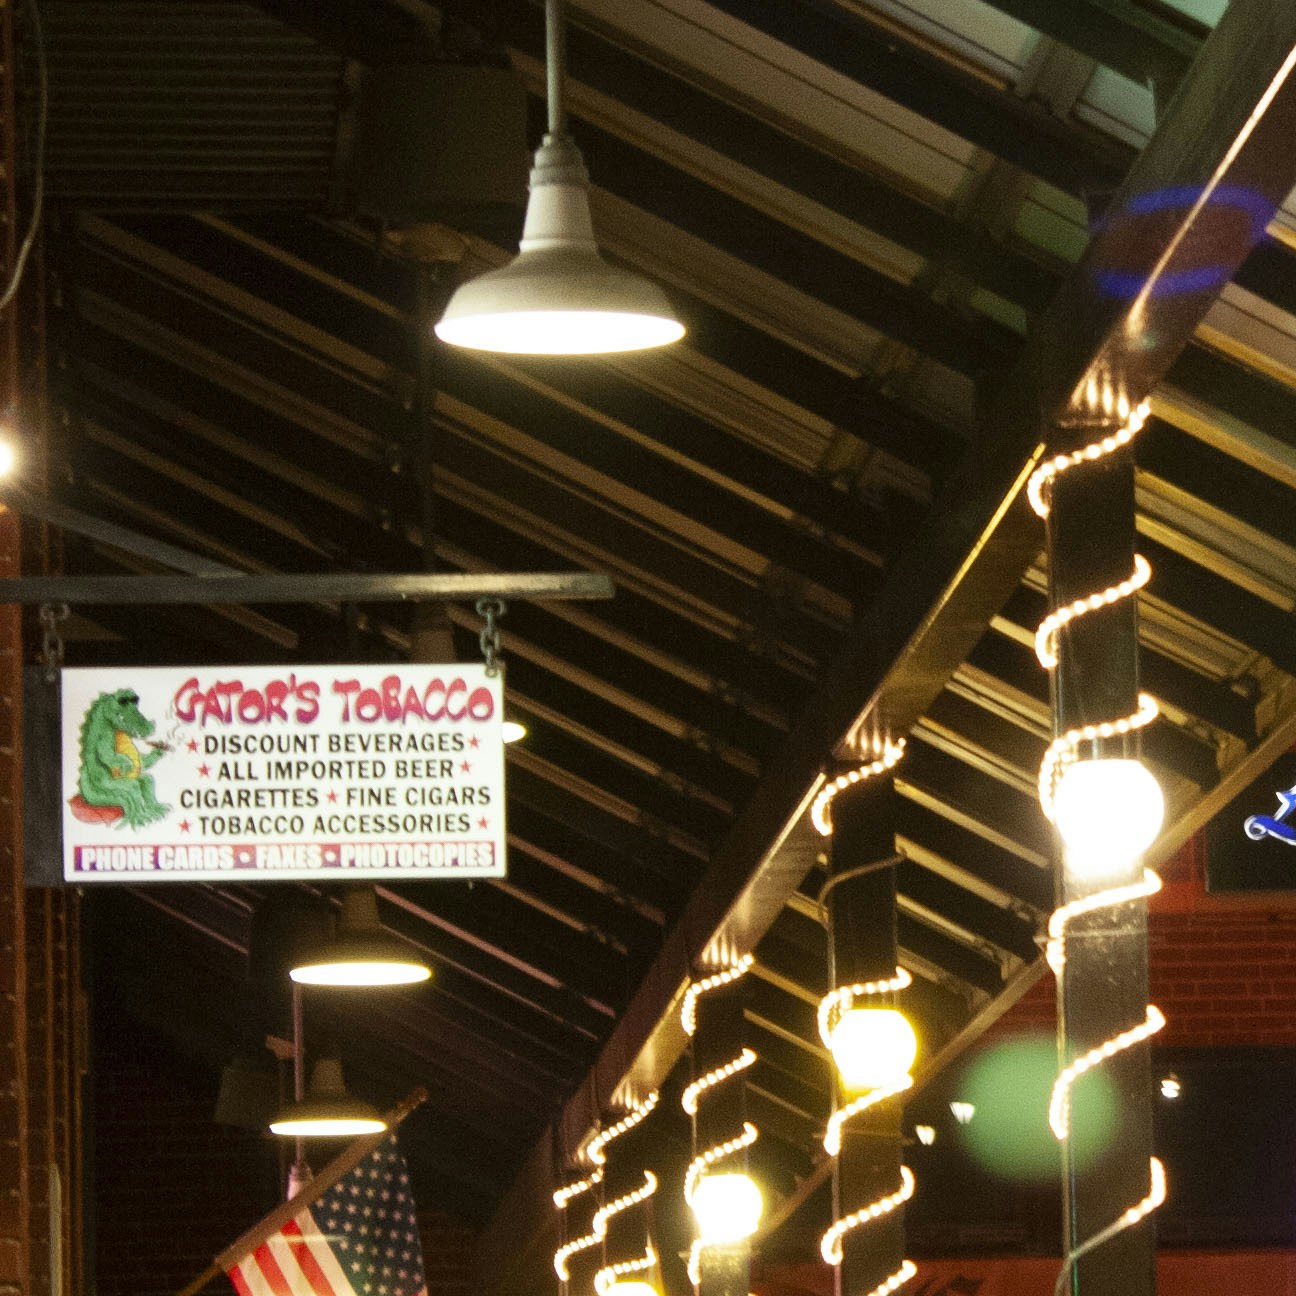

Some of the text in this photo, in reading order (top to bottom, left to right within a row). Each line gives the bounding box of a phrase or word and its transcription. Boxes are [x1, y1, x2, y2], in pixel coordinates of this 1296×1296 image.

[174, 673, 494, 727] GATOR'S TOBACCO
[204, 733, 464, 754] DISCOUNT BEVERAGES
[218, 759, 453, 781] ALL IMPORTED BEER
[180, 786, 491, 808] CIGARETTES FINE CIGARS
[200, 814, 471, 835] TOBACCO ACCESSORIES
[81, 842, 493, 871] PHONE CARDS FAXES PHOTOCOPIES
